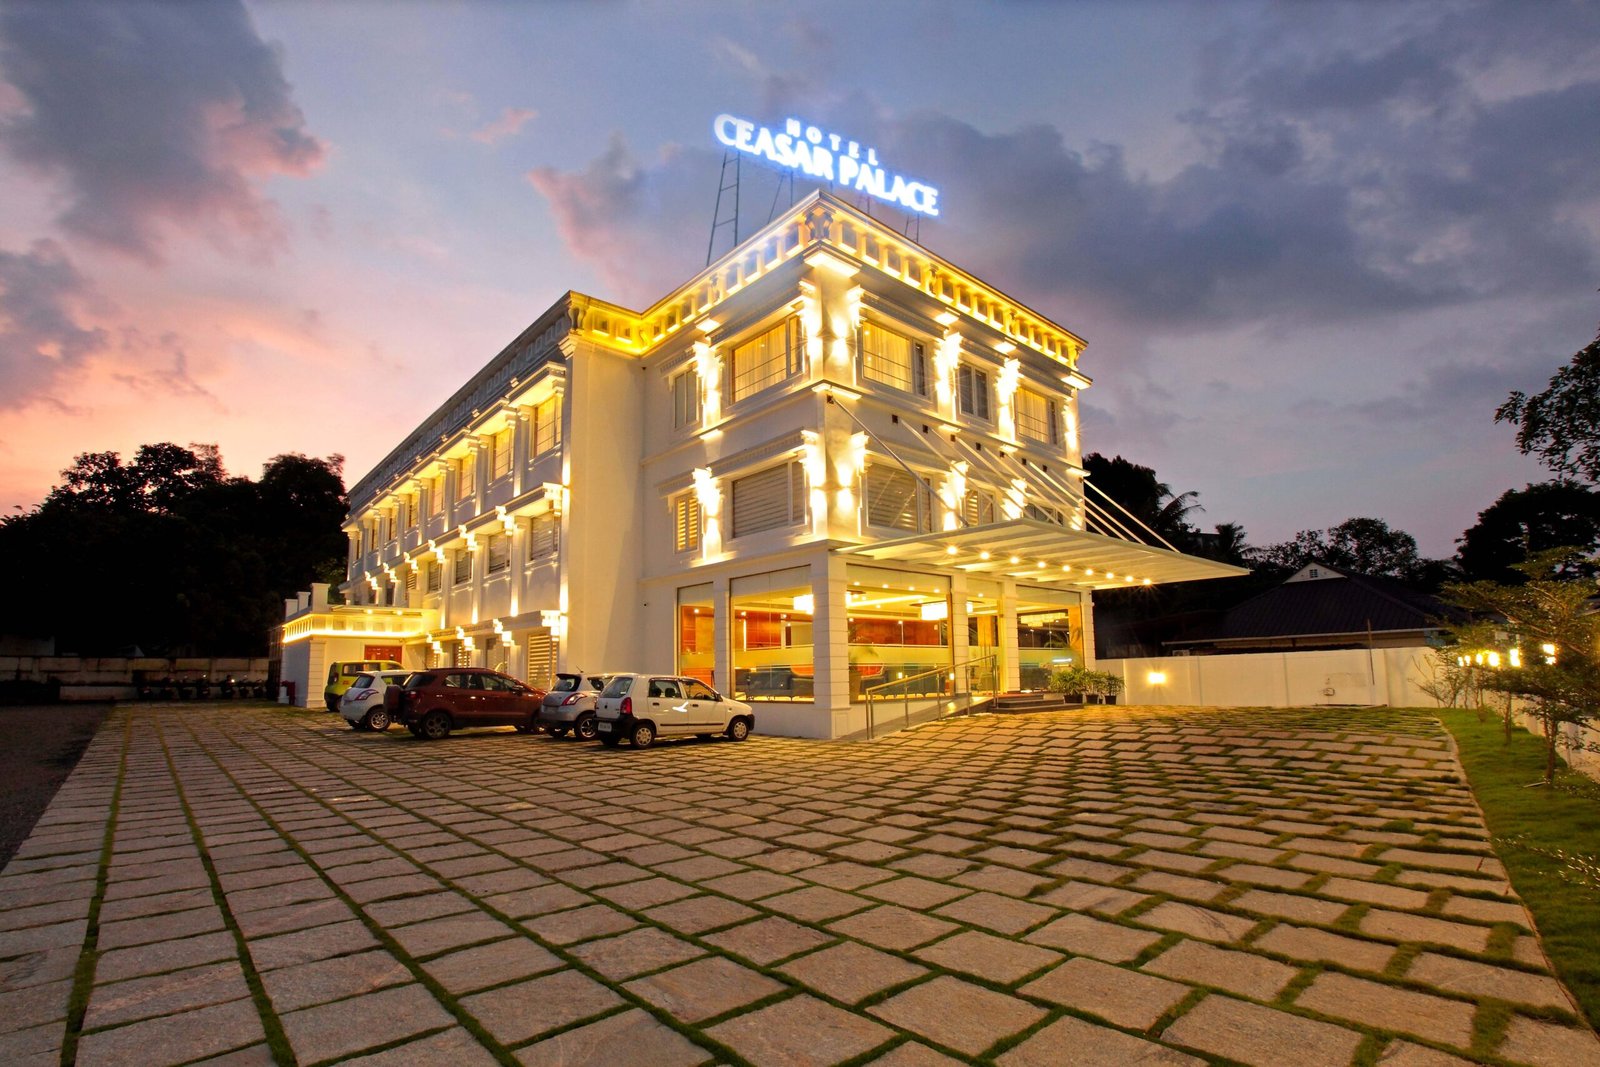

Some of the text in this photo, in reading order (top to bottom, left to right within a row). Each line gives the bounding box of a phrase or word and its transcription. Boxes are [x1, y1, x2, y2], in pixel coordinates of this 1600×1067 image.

[713, 113, 939, 216] CEASAR PALACE
[786, 118, 879, 166] HOTEL
